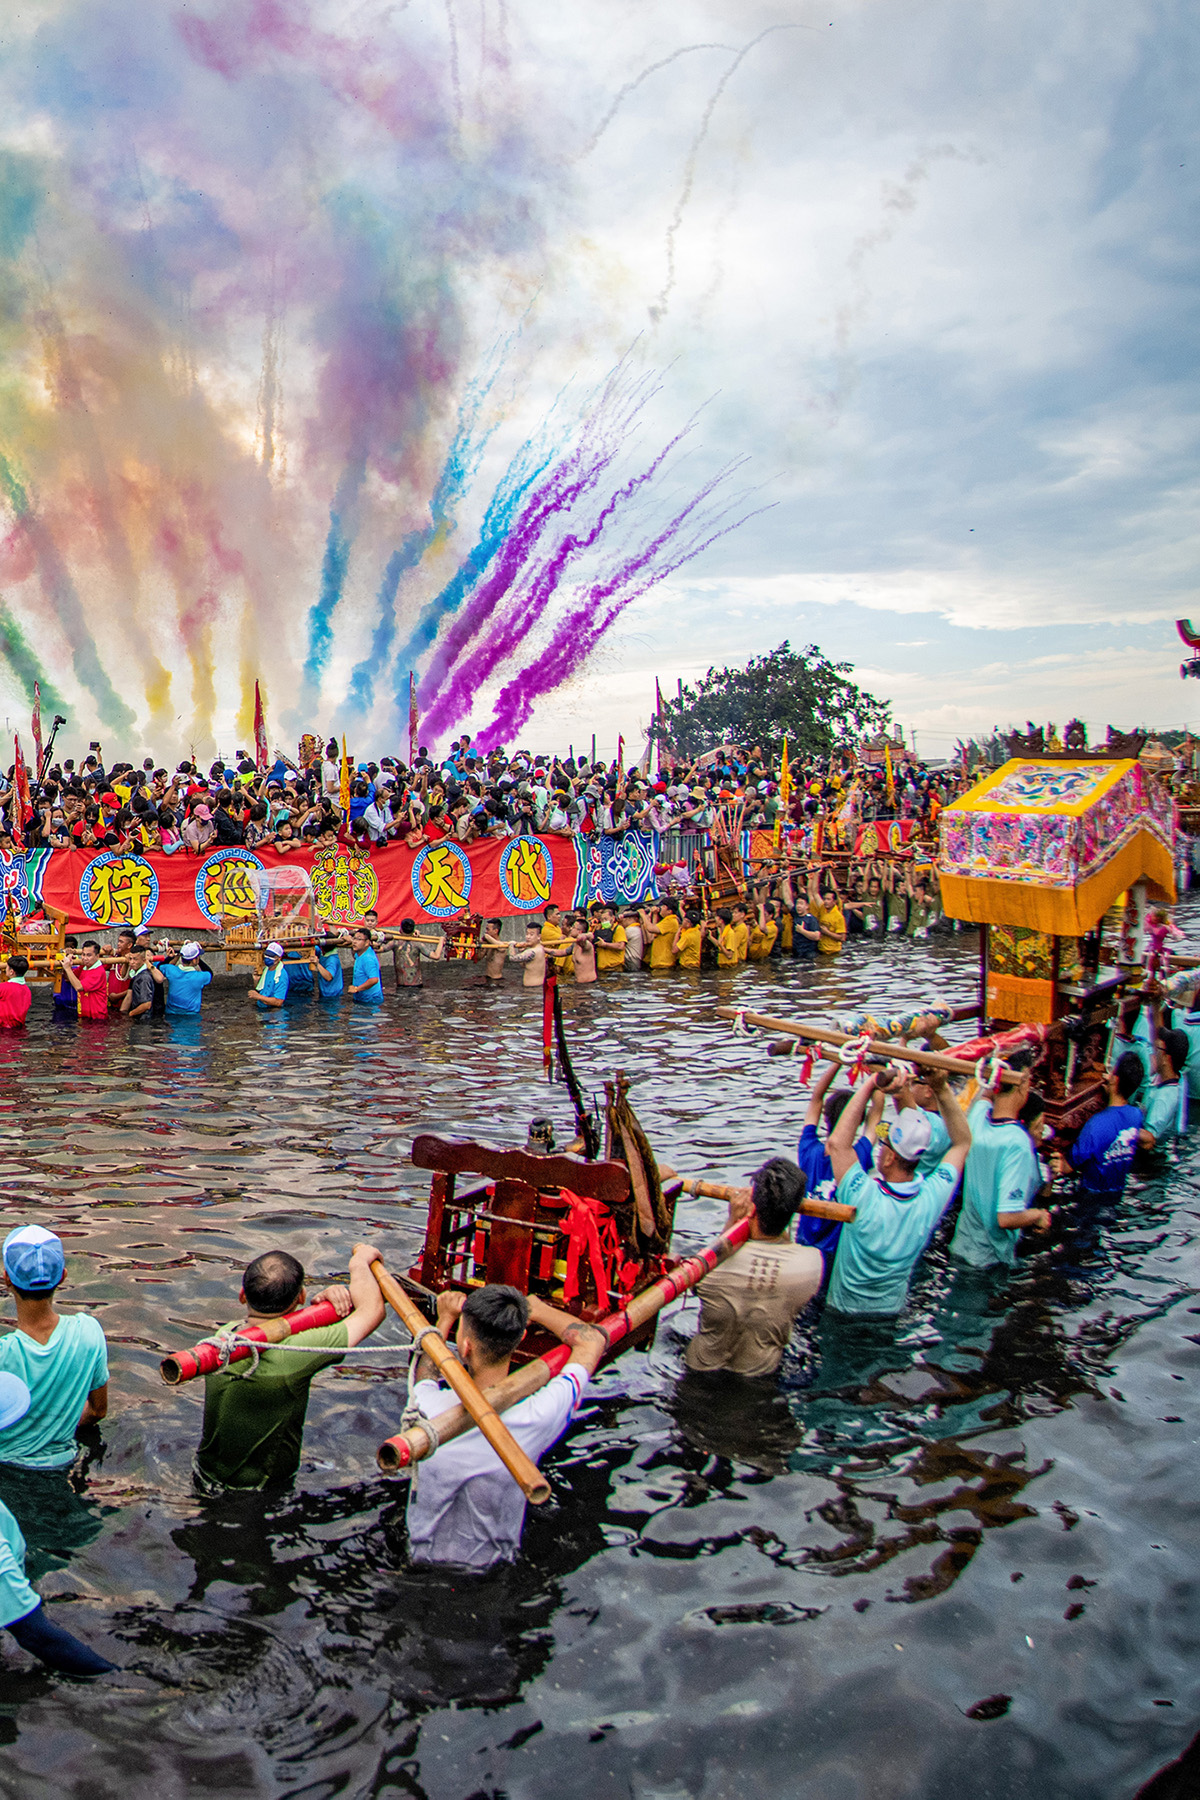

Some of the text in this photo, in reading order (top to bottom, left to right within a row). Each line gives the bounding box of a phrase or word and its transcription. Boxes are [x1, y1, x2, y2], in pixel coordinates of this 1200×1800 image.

[90, 858, 153, 926] 狩
[422, 845, 470, 907] 天
[507, 839, 551, 901] 代
